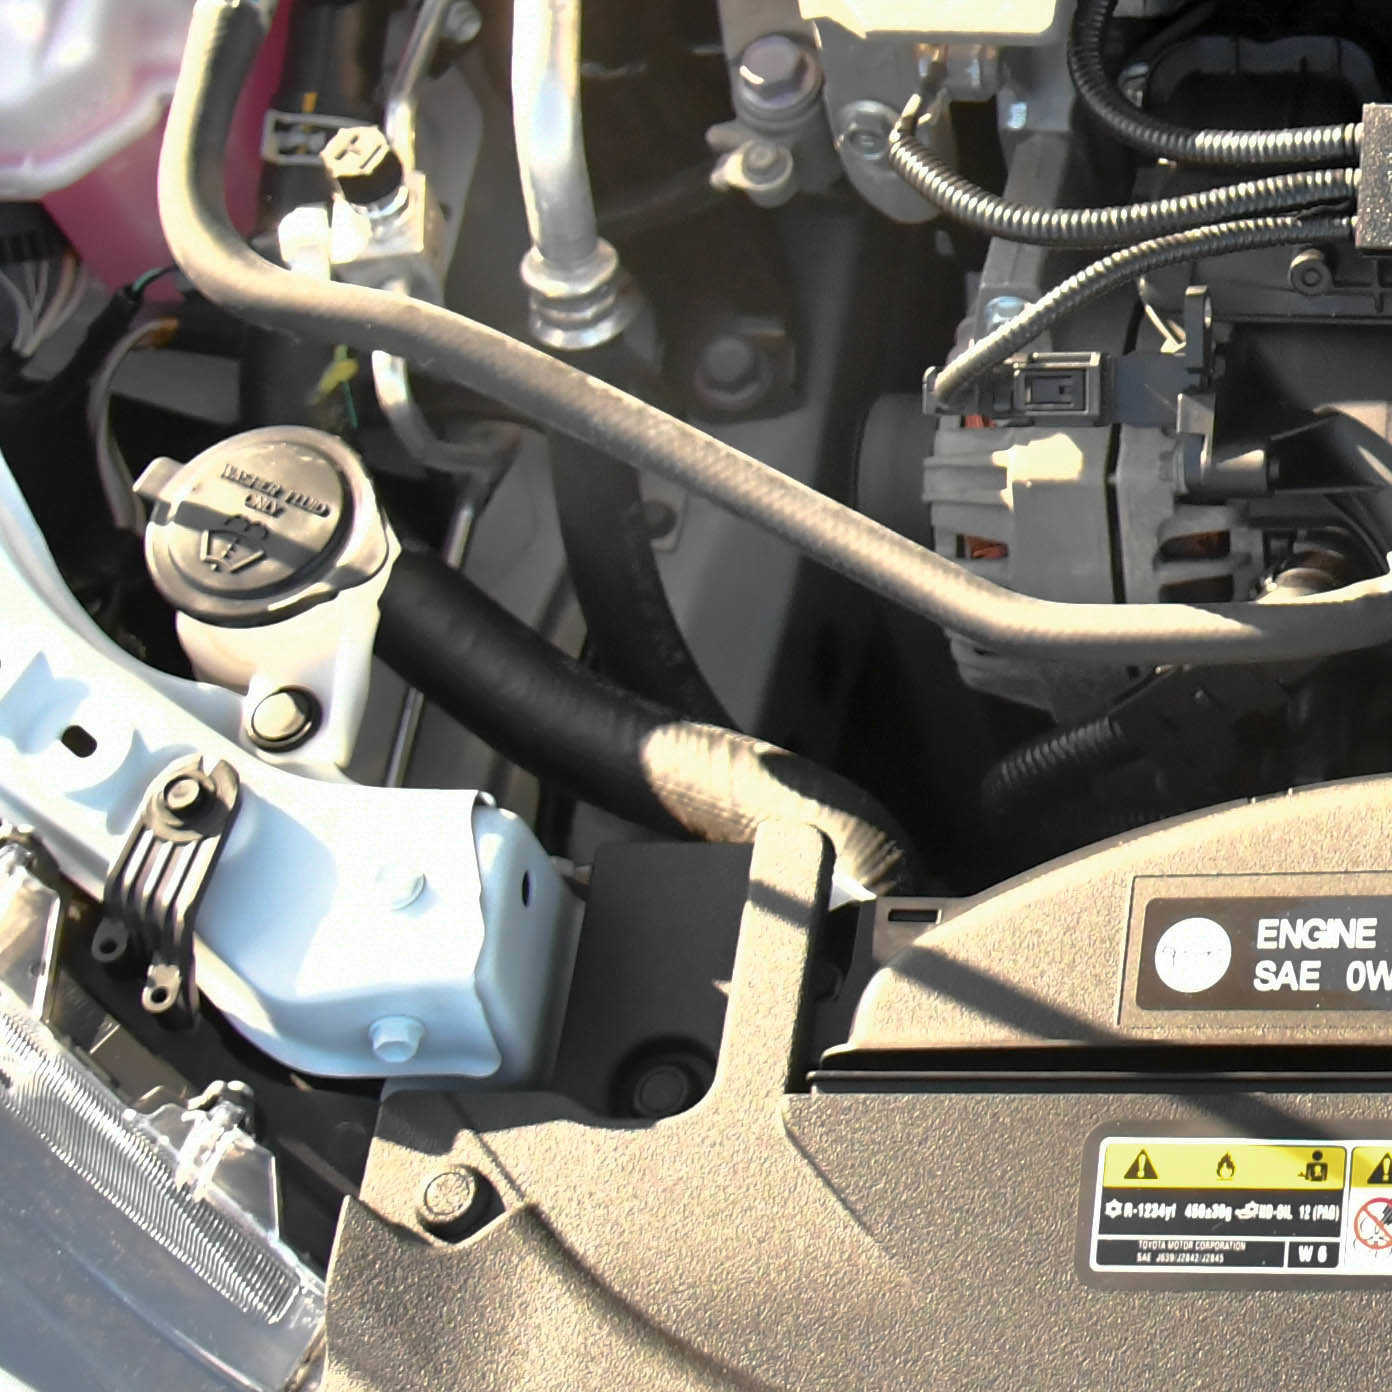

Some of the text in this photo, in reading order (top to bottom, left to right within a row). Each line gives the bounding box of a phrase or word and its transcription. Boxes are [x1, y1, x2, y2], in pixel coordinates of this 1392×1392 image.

[1256, 917, 1378, 950] ENGINE
[1253, 959, 1322, 992] SAE
[1138, 1239, 1246, 1251] TOYOTA MOTOR CORPORATION
[1298, 1244, 1314, 1263] W
[1136, 1252, 1151, 1263] SAE
